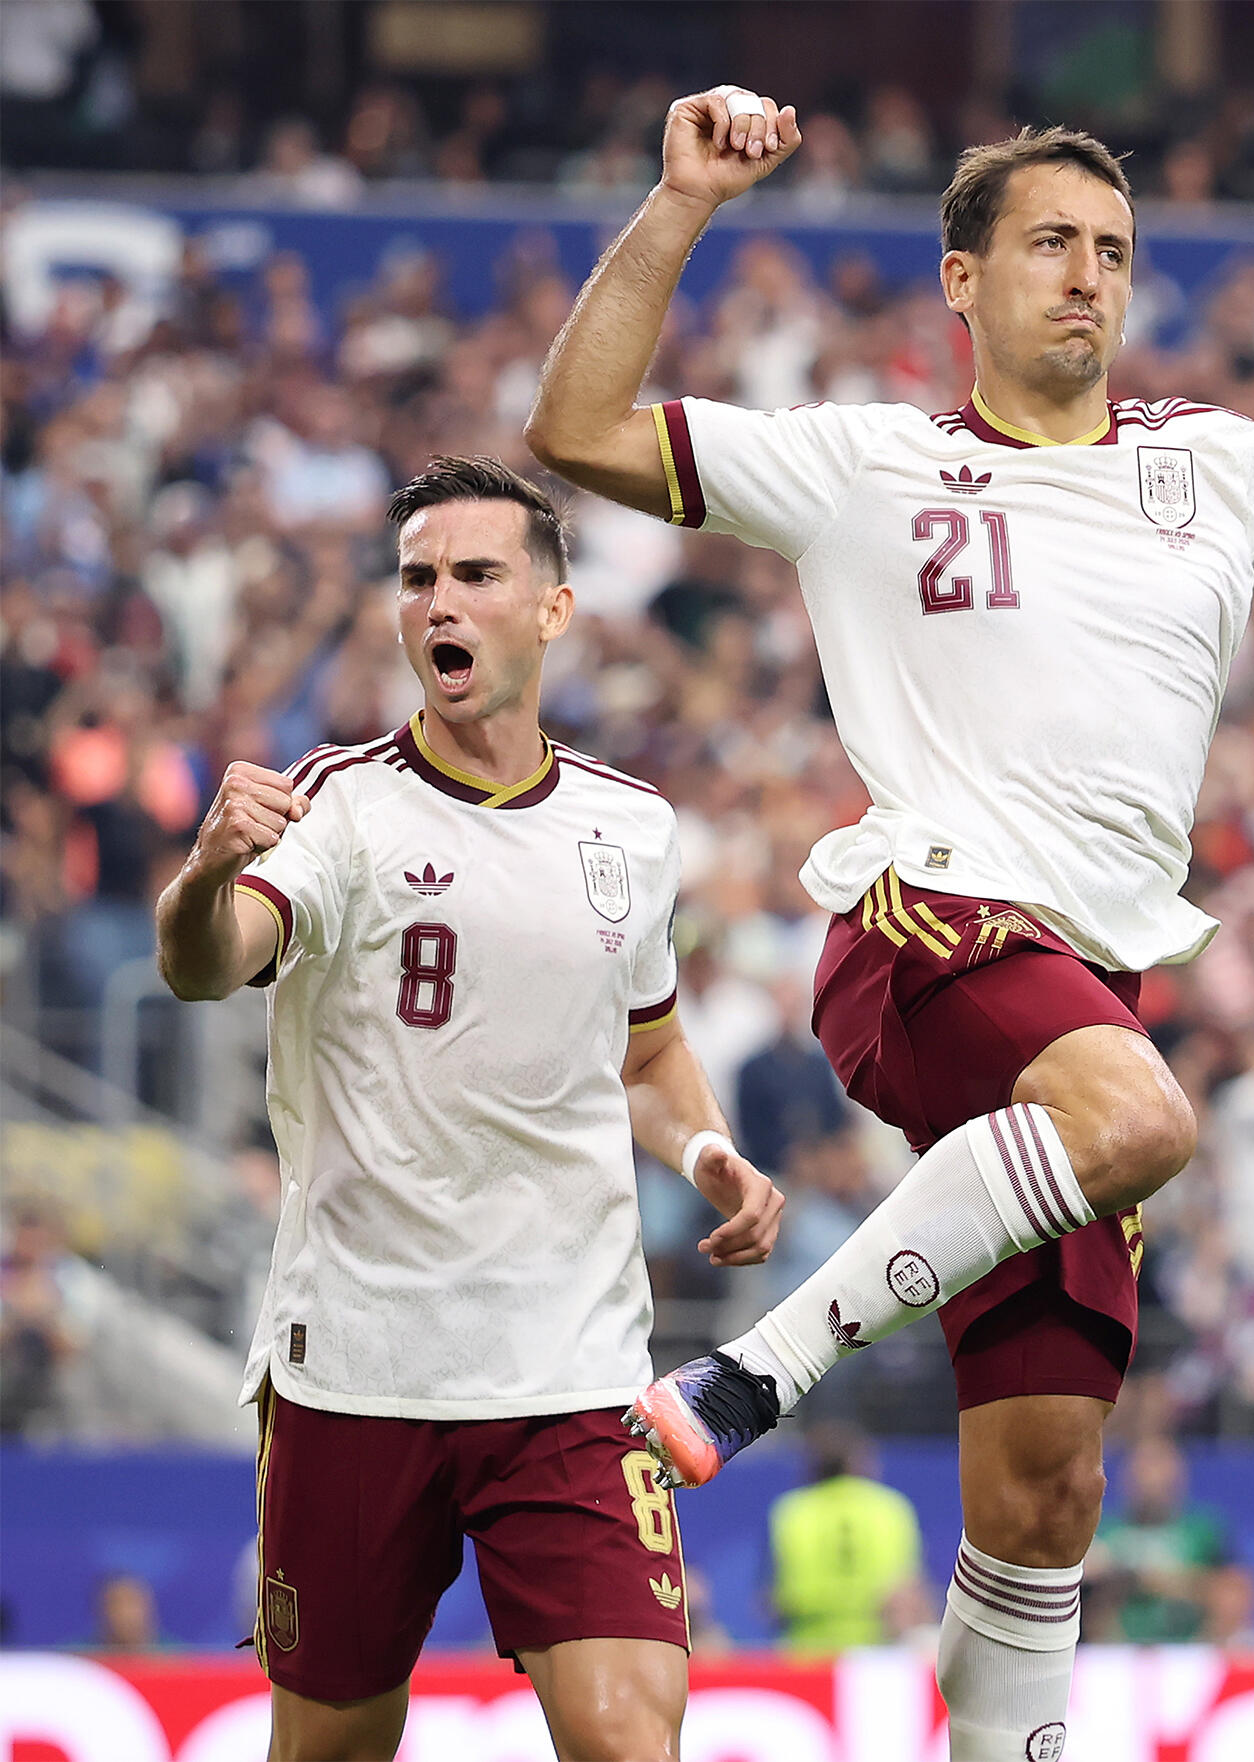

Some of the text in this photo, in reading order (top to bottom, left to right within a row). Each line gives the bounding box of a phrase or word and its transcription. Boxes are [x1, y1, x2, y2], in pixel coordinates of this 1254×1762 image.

[911, 508, 1020, 615] 21
[396, 922, 458, 1030] 8
[621, 1450, 673, 1555] 8
